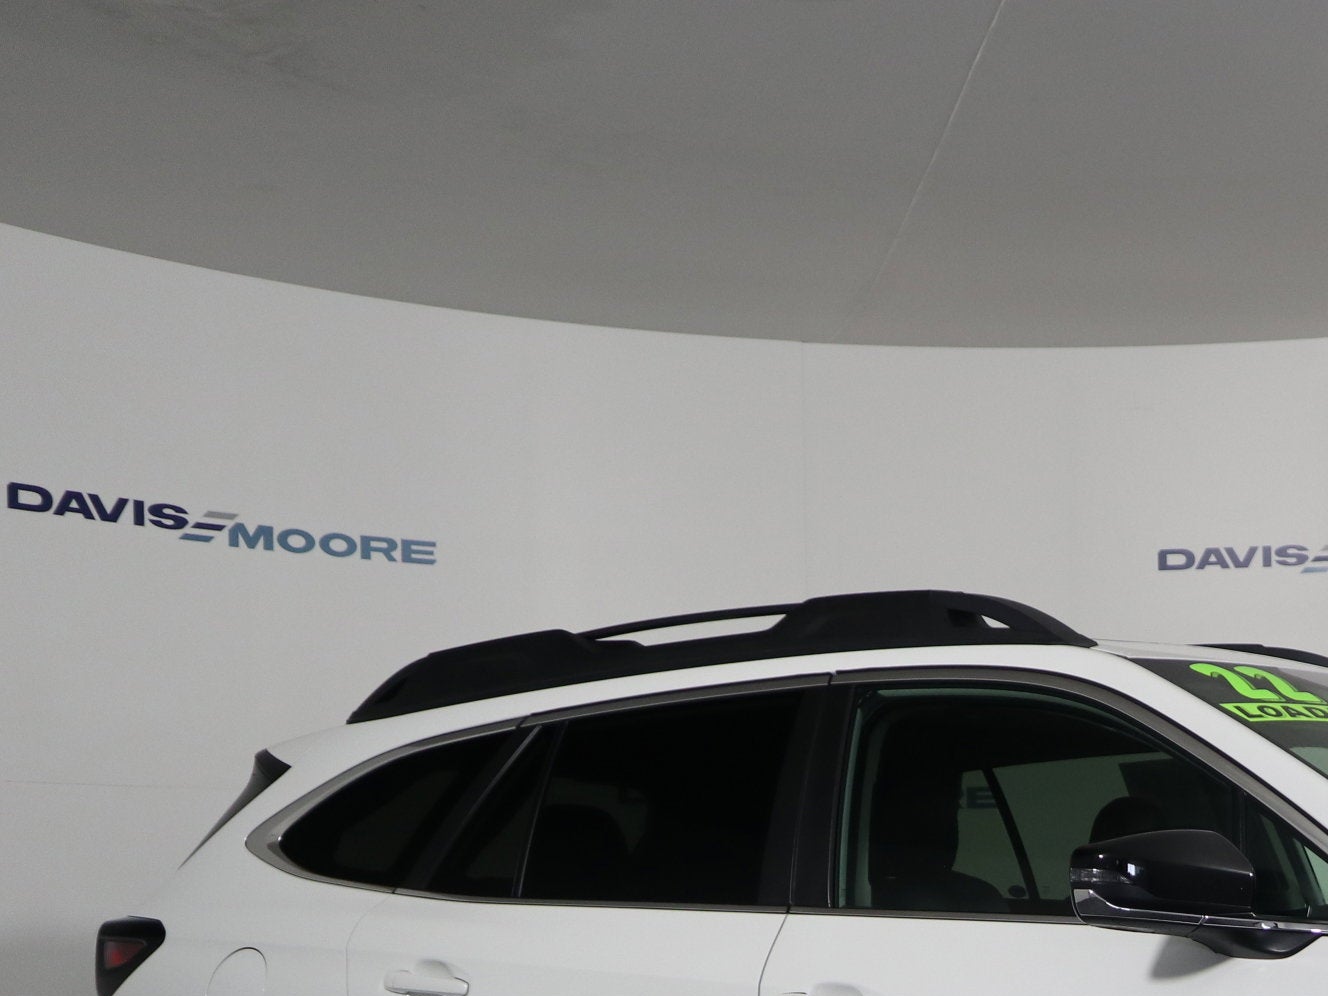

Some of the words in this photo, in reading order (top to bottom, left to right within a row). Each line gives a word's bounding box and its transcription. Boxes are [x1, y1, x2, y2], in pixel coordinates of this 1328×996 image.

[7, 482, 190, 531] DAVIS
[228, 522, 437, 566] MOORE
[1157, 544, 1310, 572] DAVIS
[1189, 662, 1328, 705] 22
